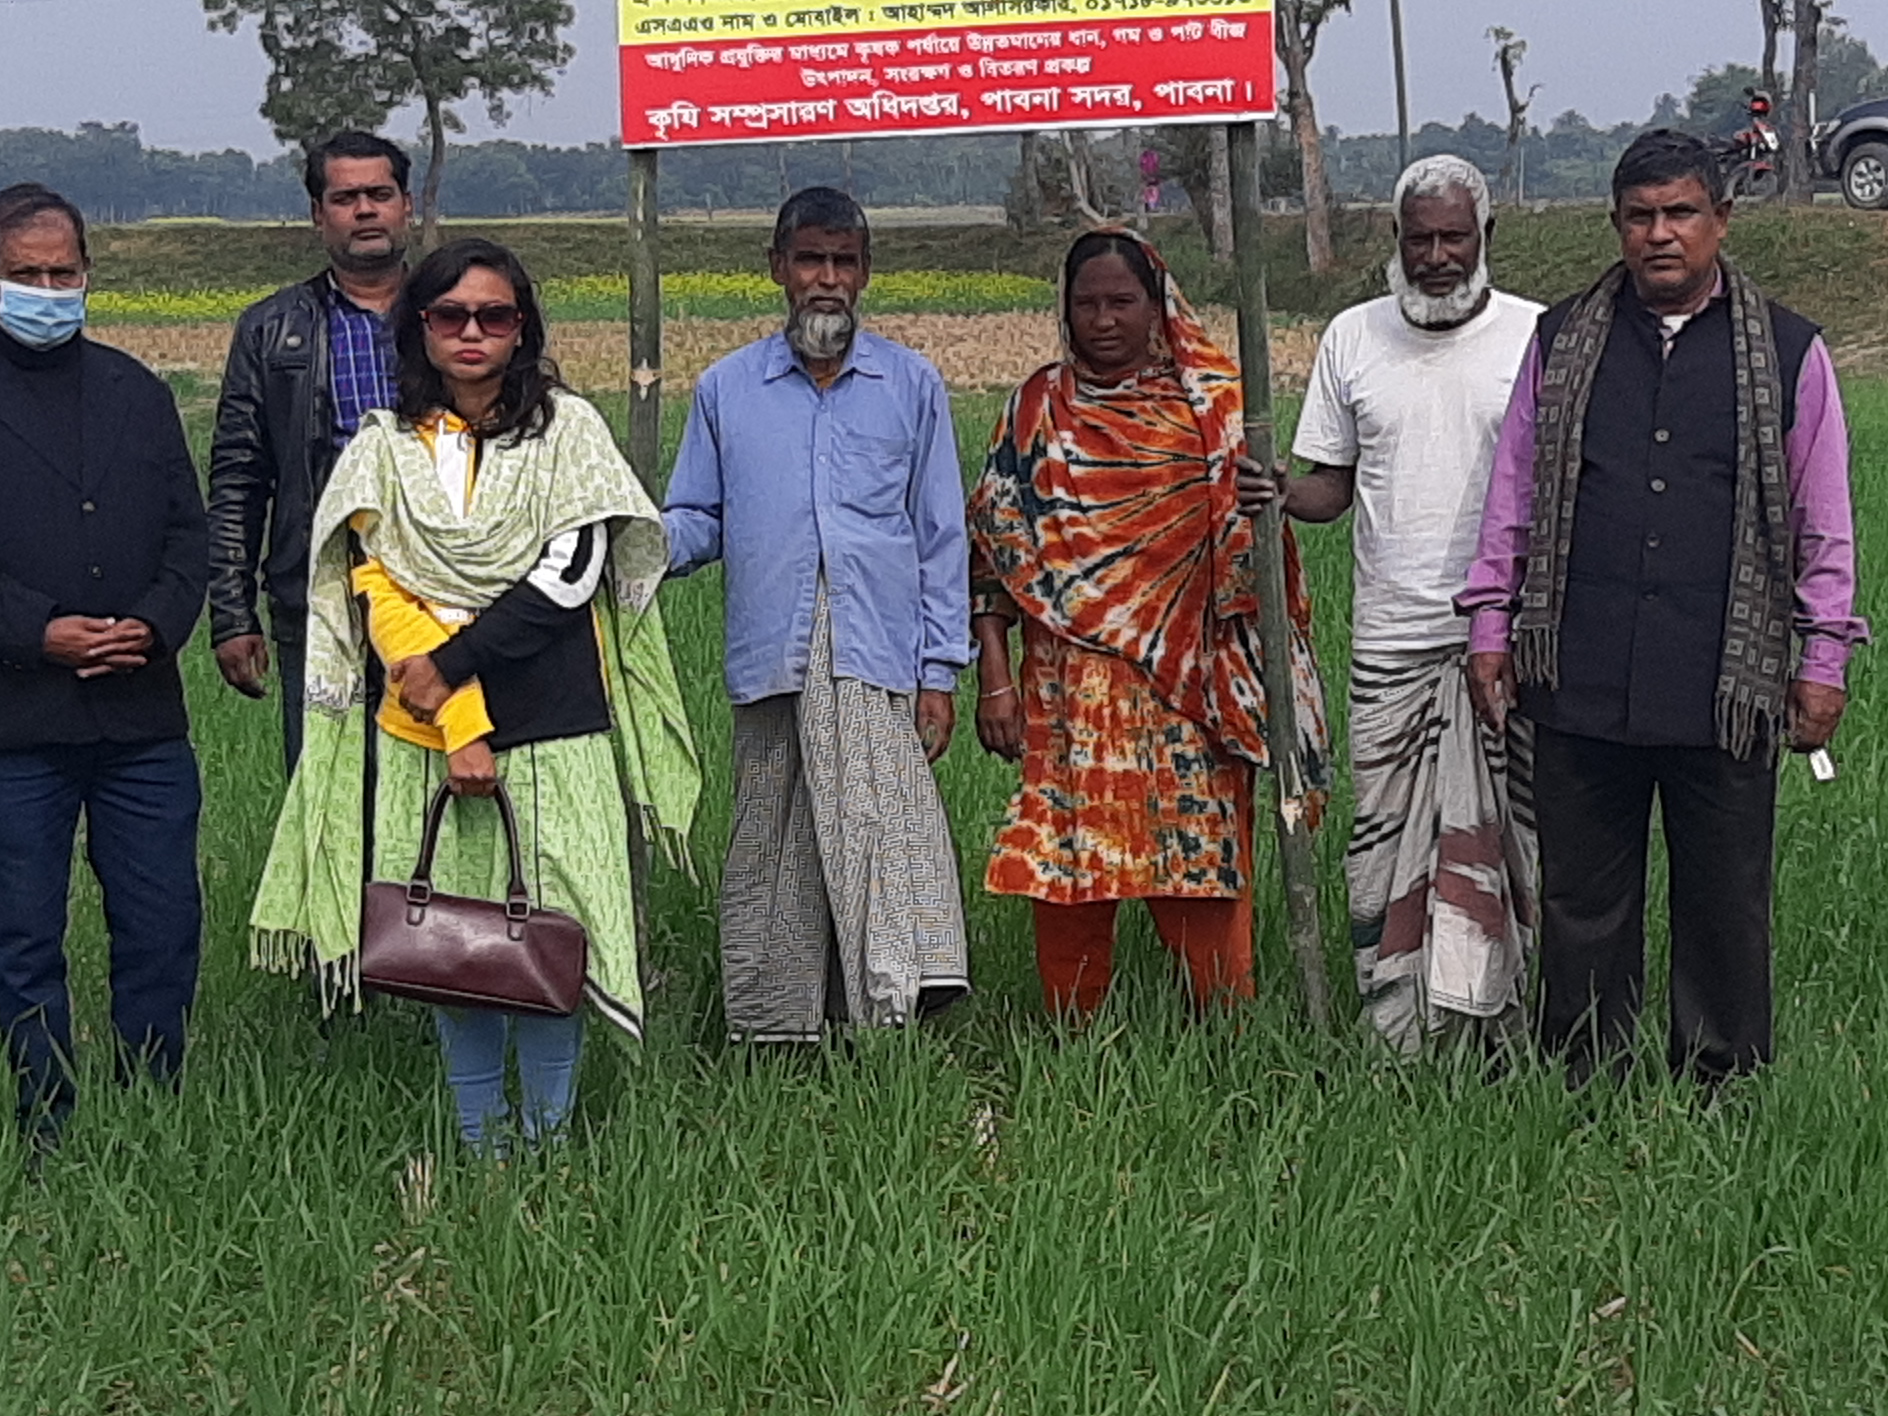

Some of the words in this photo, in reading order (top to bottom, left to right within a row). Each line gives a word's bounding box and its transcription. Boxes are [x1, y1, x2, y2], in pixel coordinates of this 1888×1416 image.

[720, 13, 754, 31] নাম
[762, 14, 777, 27] ও
[785, 6, 859, 31] মোবাইল
[646, 101, 700, 140] কৃষি
[981, 85, 1061, 113] পাবনা
[1068, 83, 1142, 111] সদর,
[1153, 79, 1235, 105] পাবনা
